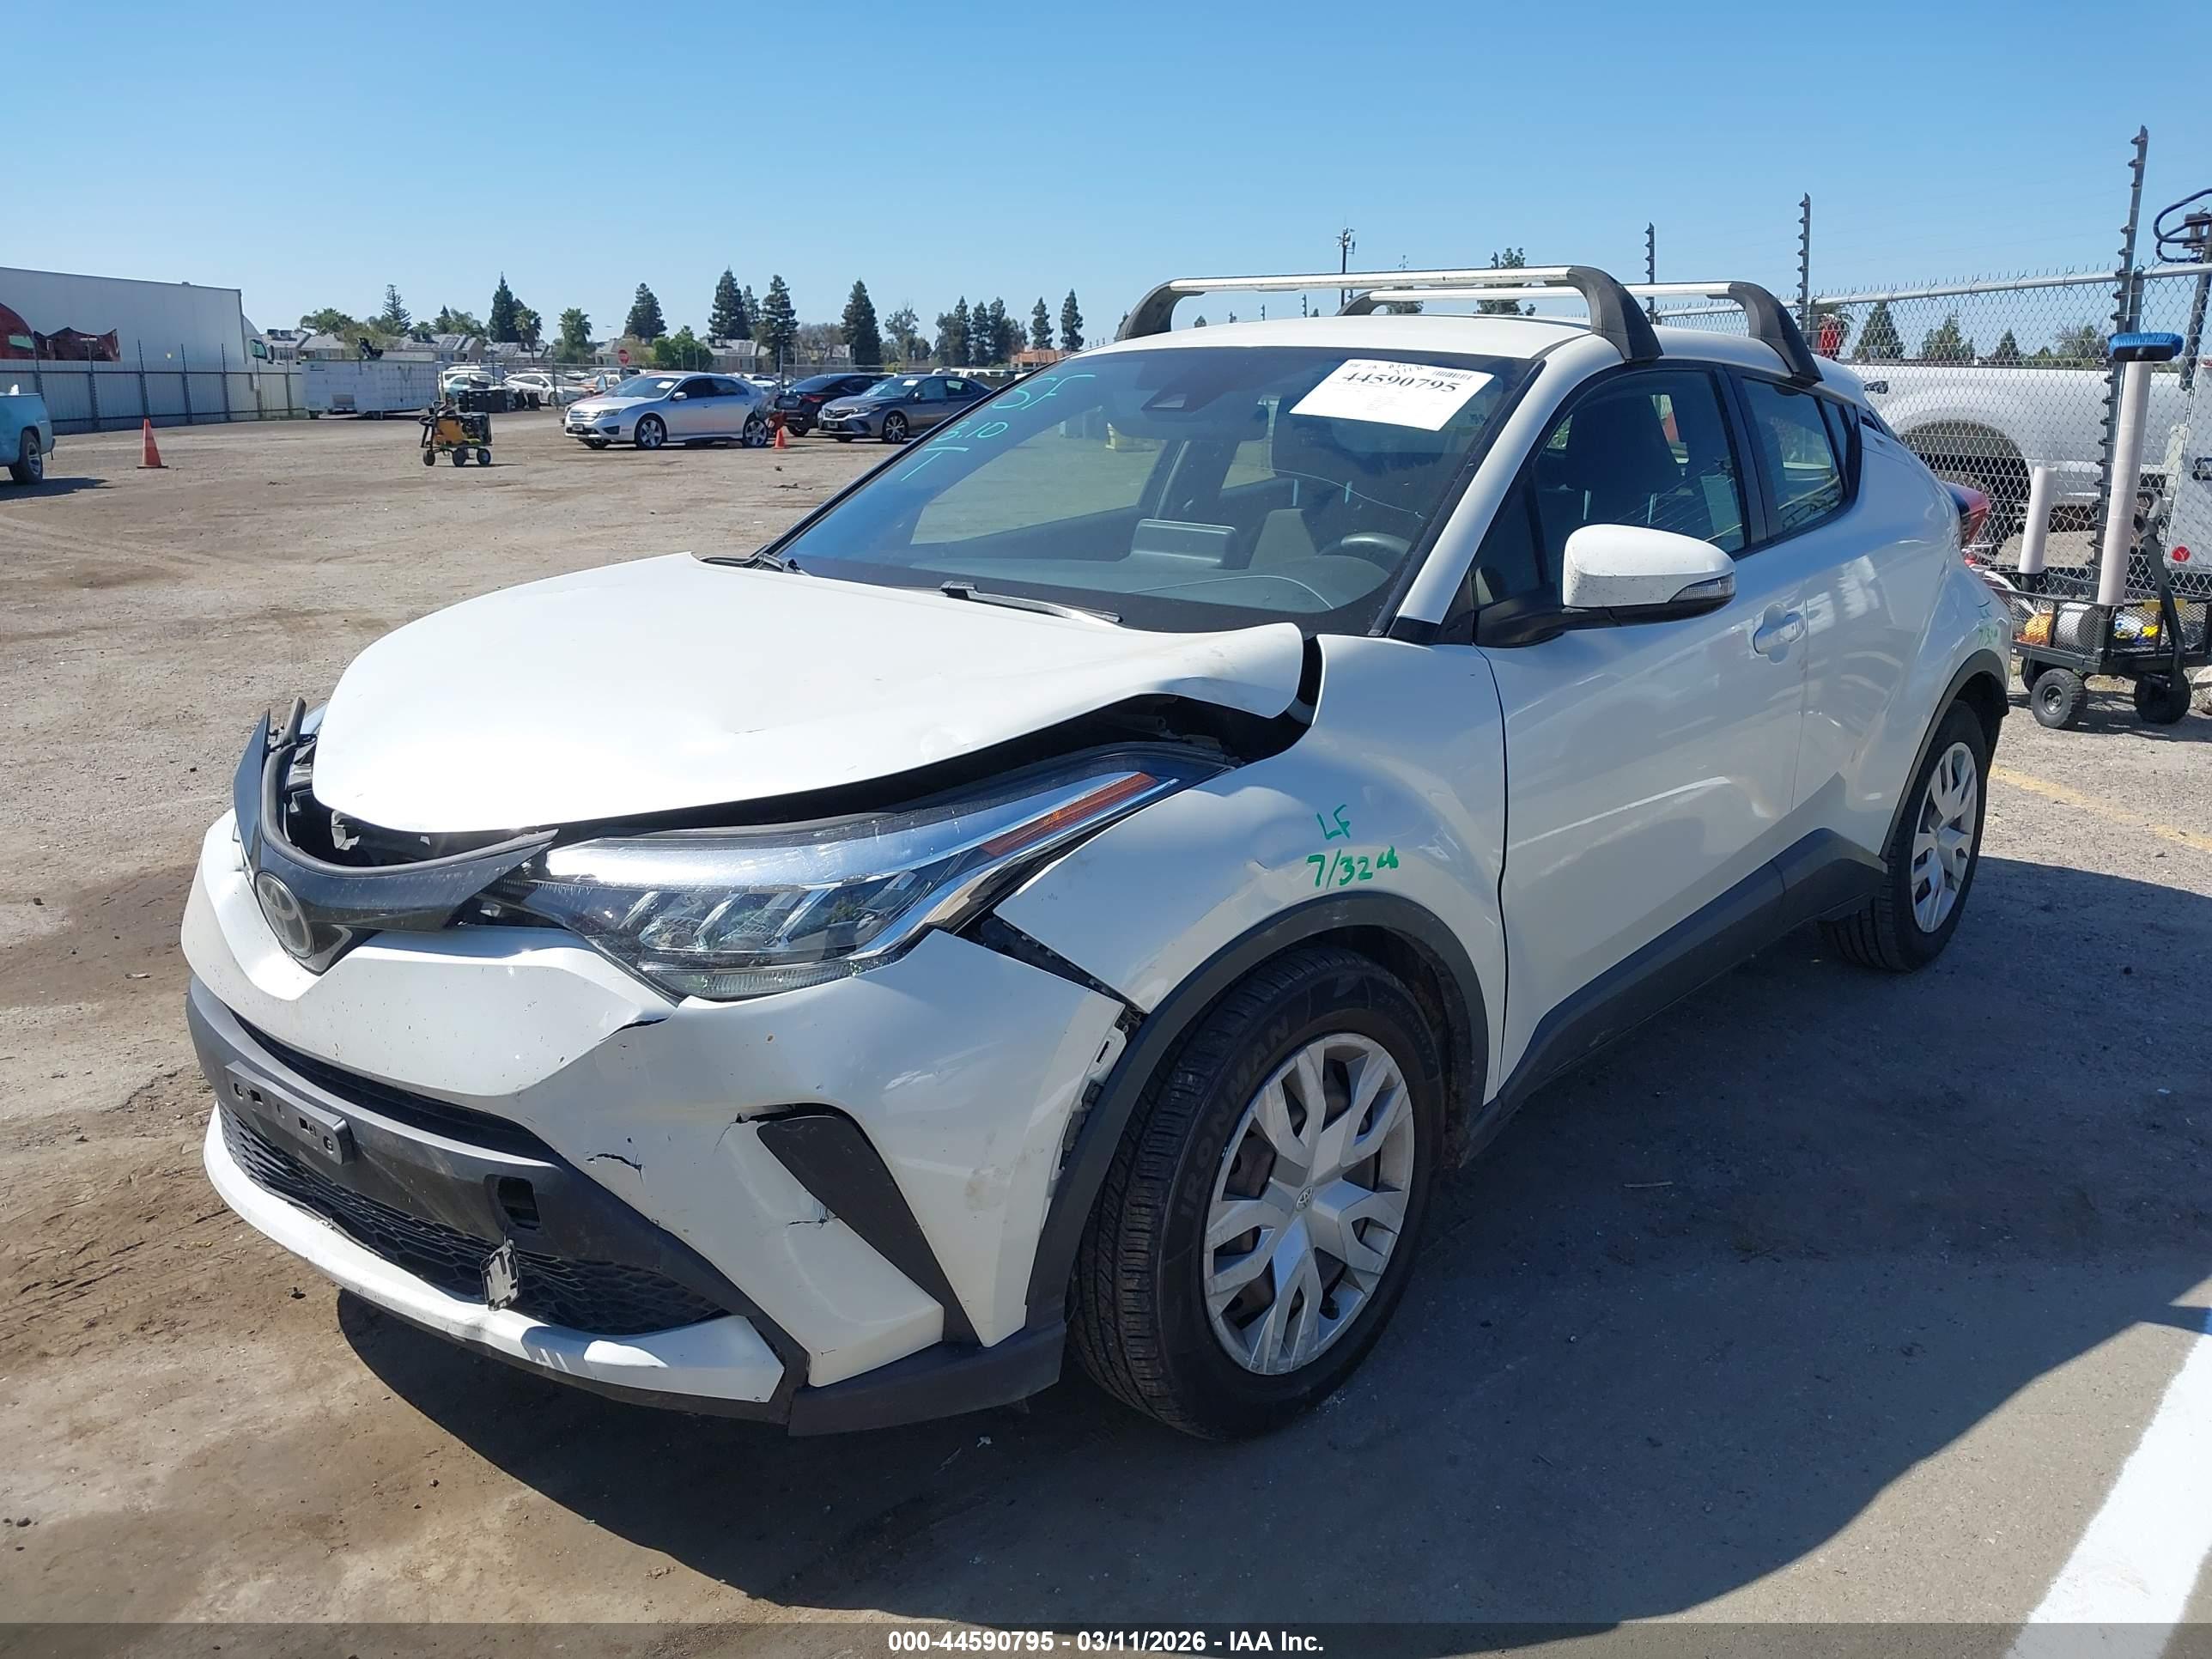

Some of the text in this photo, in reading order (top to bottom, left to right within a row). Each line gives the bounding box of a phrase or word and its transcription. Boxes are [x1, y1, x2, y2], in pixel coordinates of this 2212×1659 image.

[1341, 371, 1462, 392] 44590795
[1316, 804, 1351, 840] LF
[1179, 1013, 1291, 1218] IRONMAN
